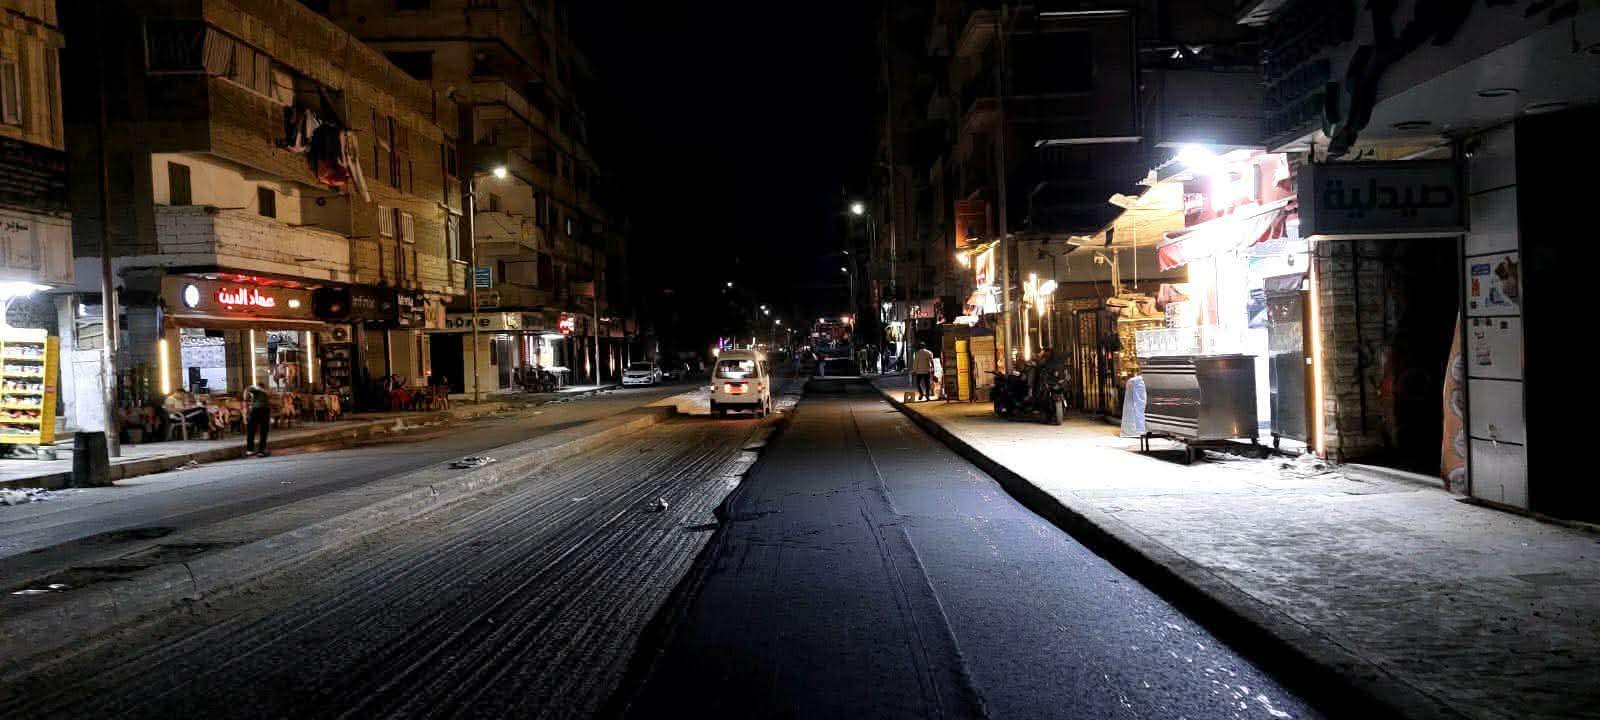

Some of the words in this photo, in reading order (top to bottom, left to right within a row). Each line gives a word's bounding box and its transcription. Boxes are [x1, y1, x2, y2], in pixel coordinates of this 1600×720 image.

[1323, 177, 1454, 219] صيدلية
[218, 287, 248, 310] الدين
[249, 289, 276, 308] عماد
